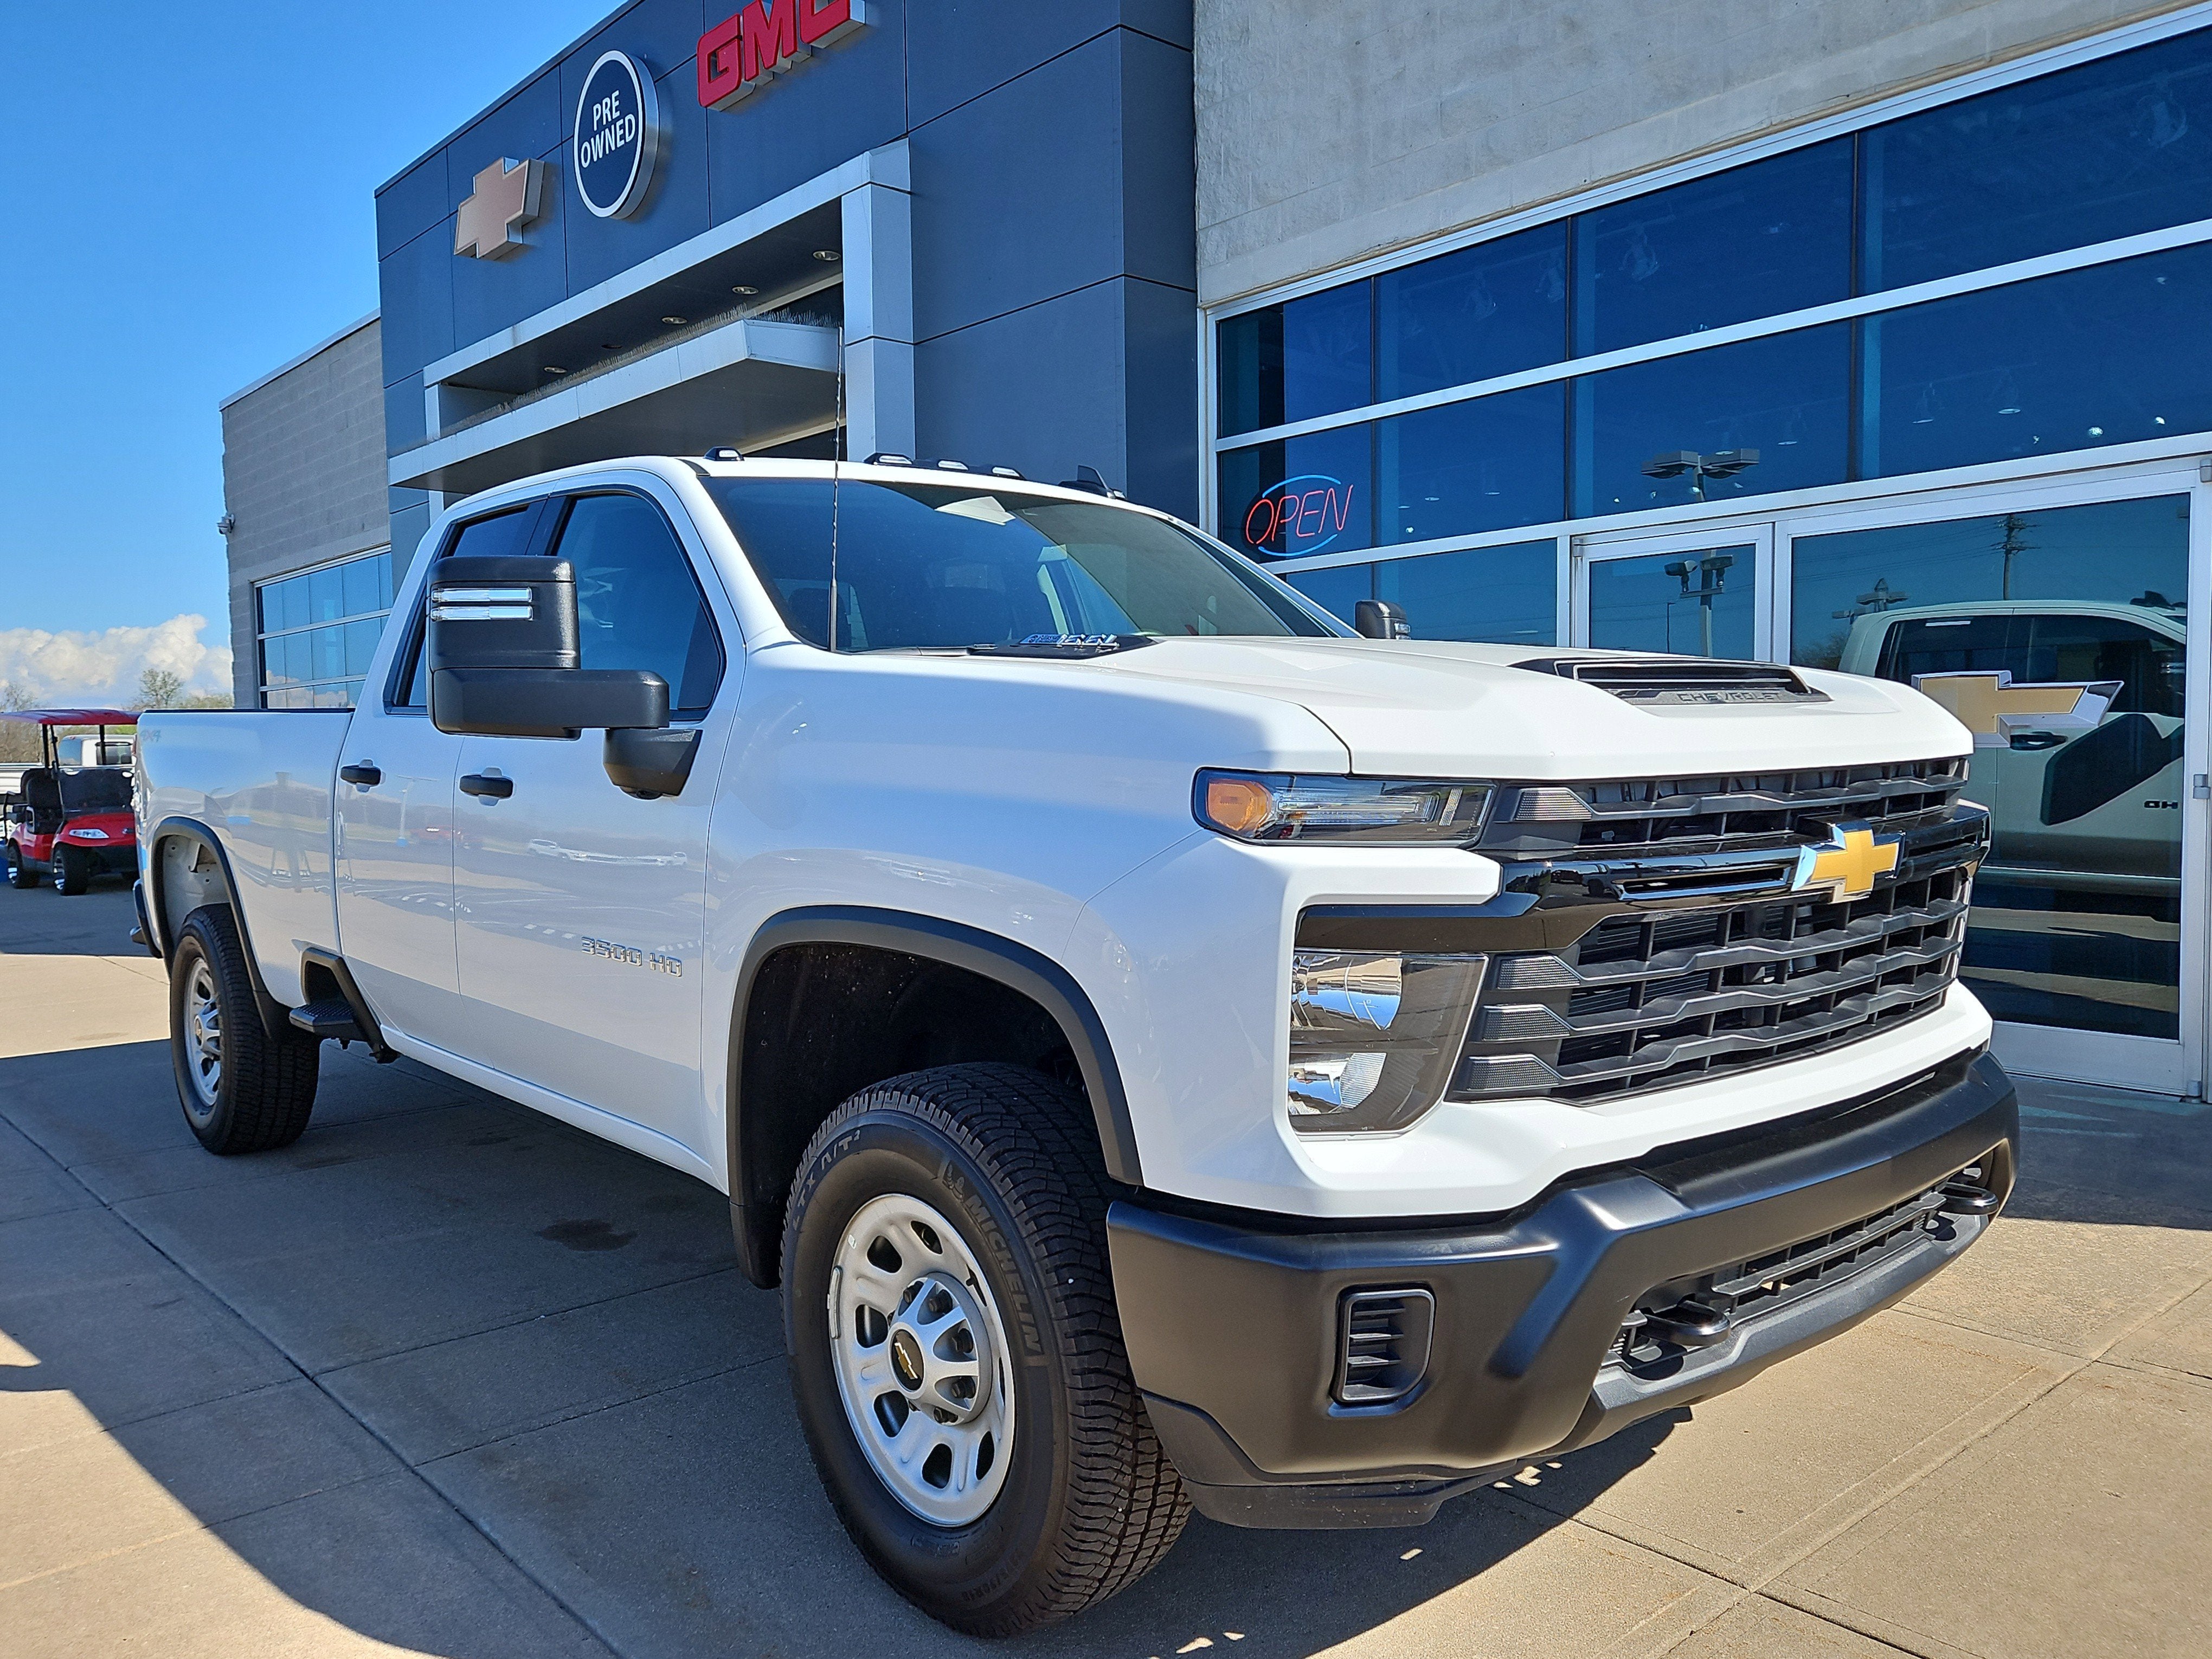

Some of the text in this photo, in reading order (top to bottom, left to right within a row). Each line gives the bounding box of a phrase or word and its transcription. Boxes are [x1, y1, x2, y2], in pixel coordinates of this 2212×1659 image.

[593, 90, 621, 131] PRE
[581, 113, 636, 168] OWNED
[1246, 484, 1354, 544] OPEN
[1676, 692, 1782, 702] CHEVROLET
[581, 936, 682, 978] 3500 HD
[965, 1193, 1042, 1354] MICHELIN
